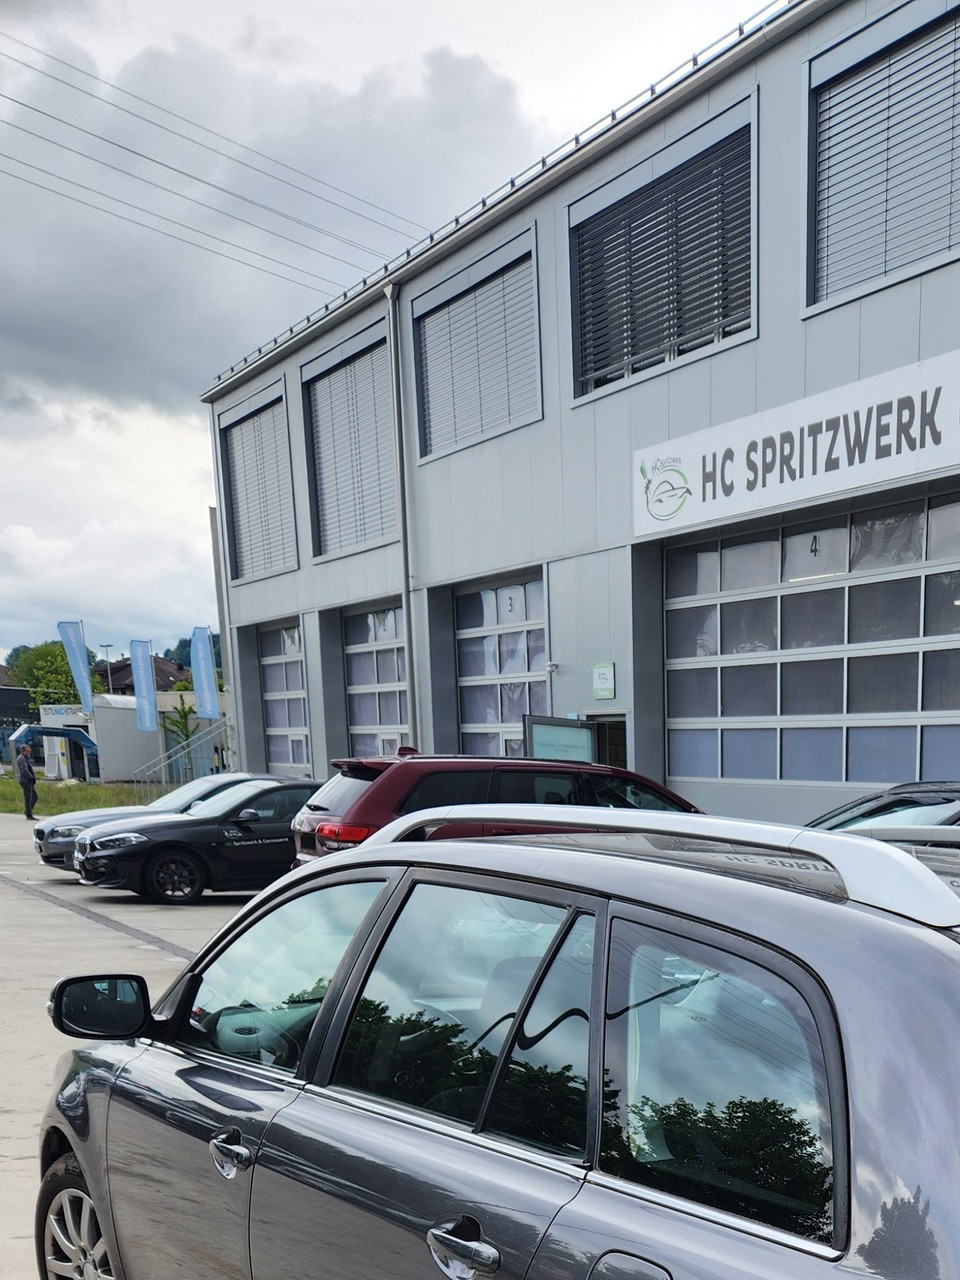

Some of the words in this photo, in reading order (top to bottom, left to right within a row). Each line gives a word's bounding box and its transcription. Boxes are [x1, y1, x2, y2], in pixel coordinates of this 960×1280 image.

[702, 447, 735, 502] HC
[745, 385, 942, 492] SPRITZWERK
[810, 535, 818, 557] 4
